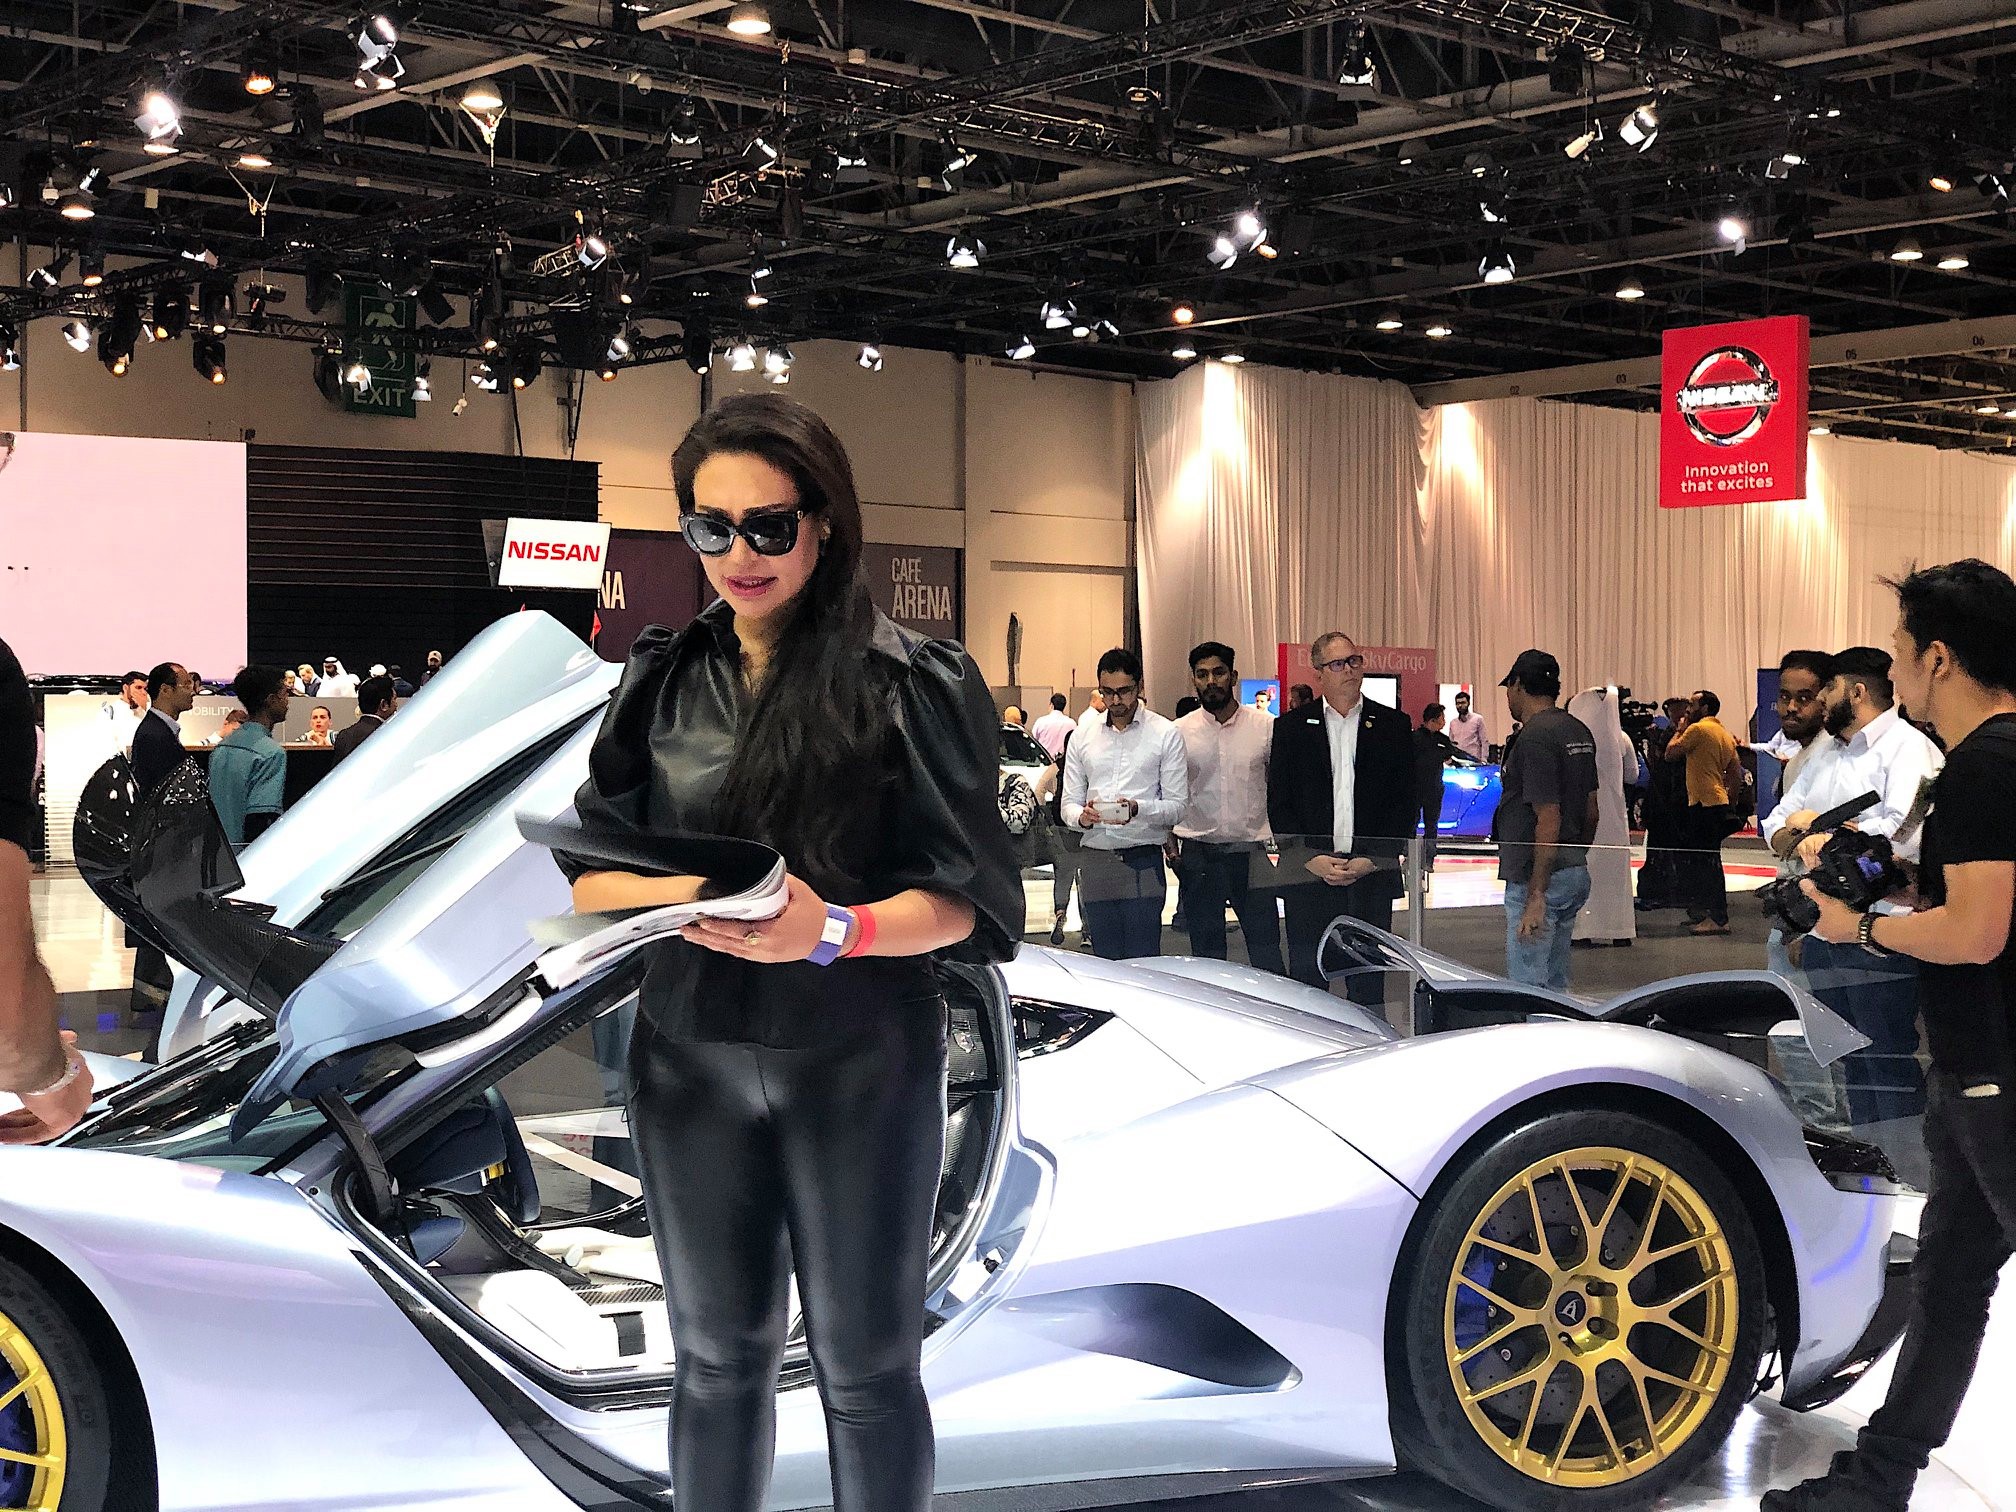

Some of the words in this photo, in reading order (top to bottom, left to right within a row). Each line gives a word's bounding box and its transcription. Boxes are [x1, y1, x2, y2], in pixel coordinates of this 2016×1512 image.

[1616, 373, 1627, 384] 03
[353, 386, 406, 408] EXIT
[1509, 385, 1520, 395] 02
[1685, 461, 1769, 478] Innovation
[1681, 480, 1713, 493] that
[1717, 475, 1774, 490] excites
[508, 541, 600, 561] NISSAN
[892, 557, 921, 583] CAFE
[892, 584, 952, 620] ARENA
[1362, 650, 1427, 674] SkyCargo
[190, 706, 234, 716] OBILITY
